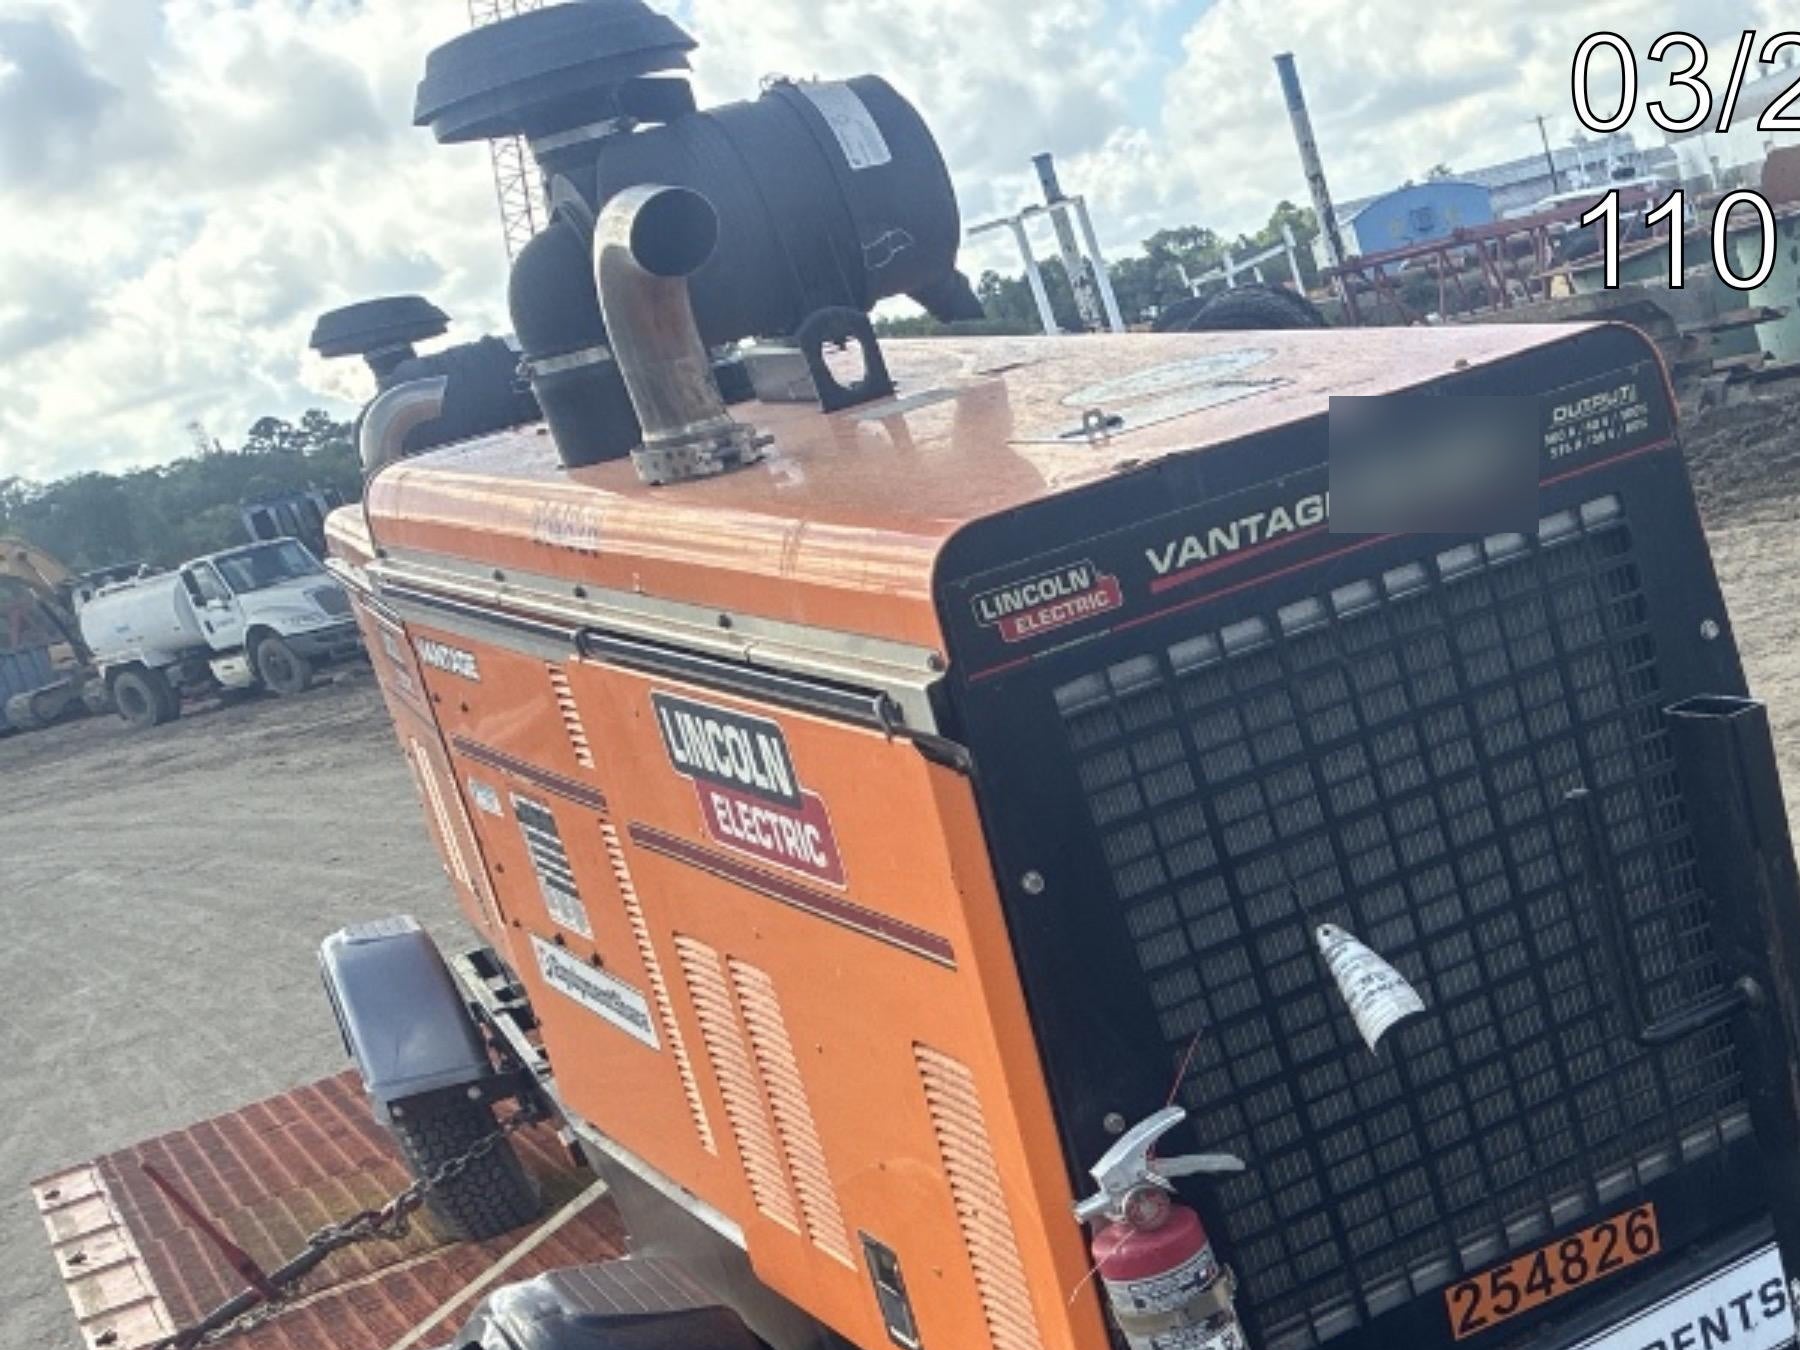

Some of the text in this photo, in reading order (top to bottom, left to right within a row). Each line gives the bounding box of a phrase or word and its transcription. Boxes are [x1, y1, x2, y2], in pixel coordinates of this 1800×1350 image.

[1145, 491, 1330, 575] VANTAG
[980, 566, 1090, 620] LINCOLN
[1014, 590, 1109, 634] ELECTRIC
[660, 706, 793, 798] LINCOLN
[710, 791, 829, 868] ELECTRIC
[1452, 1207, 1658, 1333] 254826
